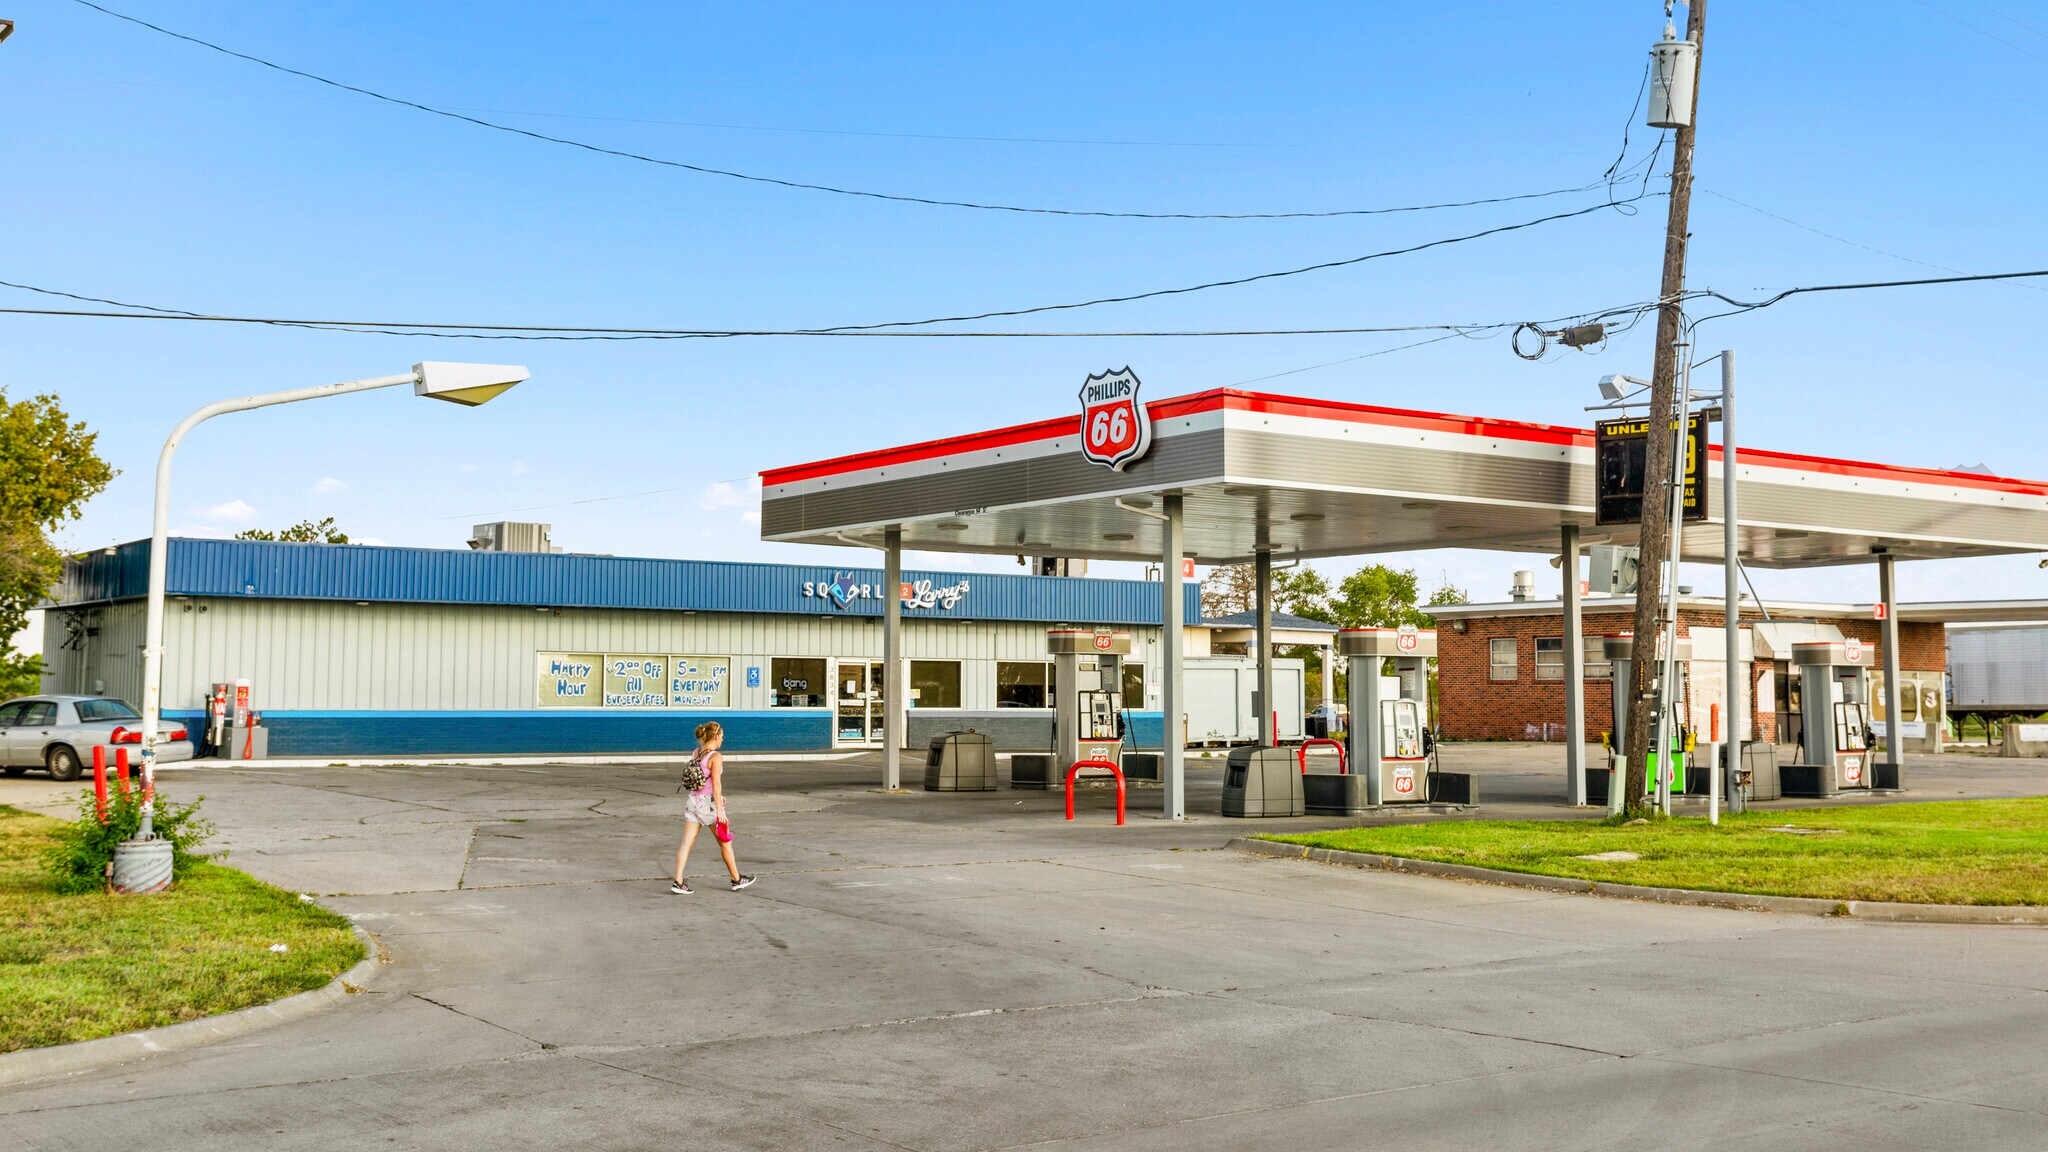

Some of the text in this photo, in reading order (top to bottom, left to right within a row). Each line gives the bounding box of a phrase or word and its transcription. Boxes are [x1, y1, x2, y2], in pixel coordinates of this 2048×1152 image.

[1088, 378, 1131, 402] PHILLIPS
[1091, 407, 1129, 447] 66
[1183, 563, 1190, 574] 4
[902, 587, 909, 597] 2
[905, 579, 971, 610] Larry's
[1096, 636, 1110, 647] 66
[1401, 635, 1415, 647] 66
[1847, 648, 1858, 658] 66
[783, 677, 808, 691] bang
[1847, 767, 1858, 778] 66
[1397, 778, 1411, 790] 66
